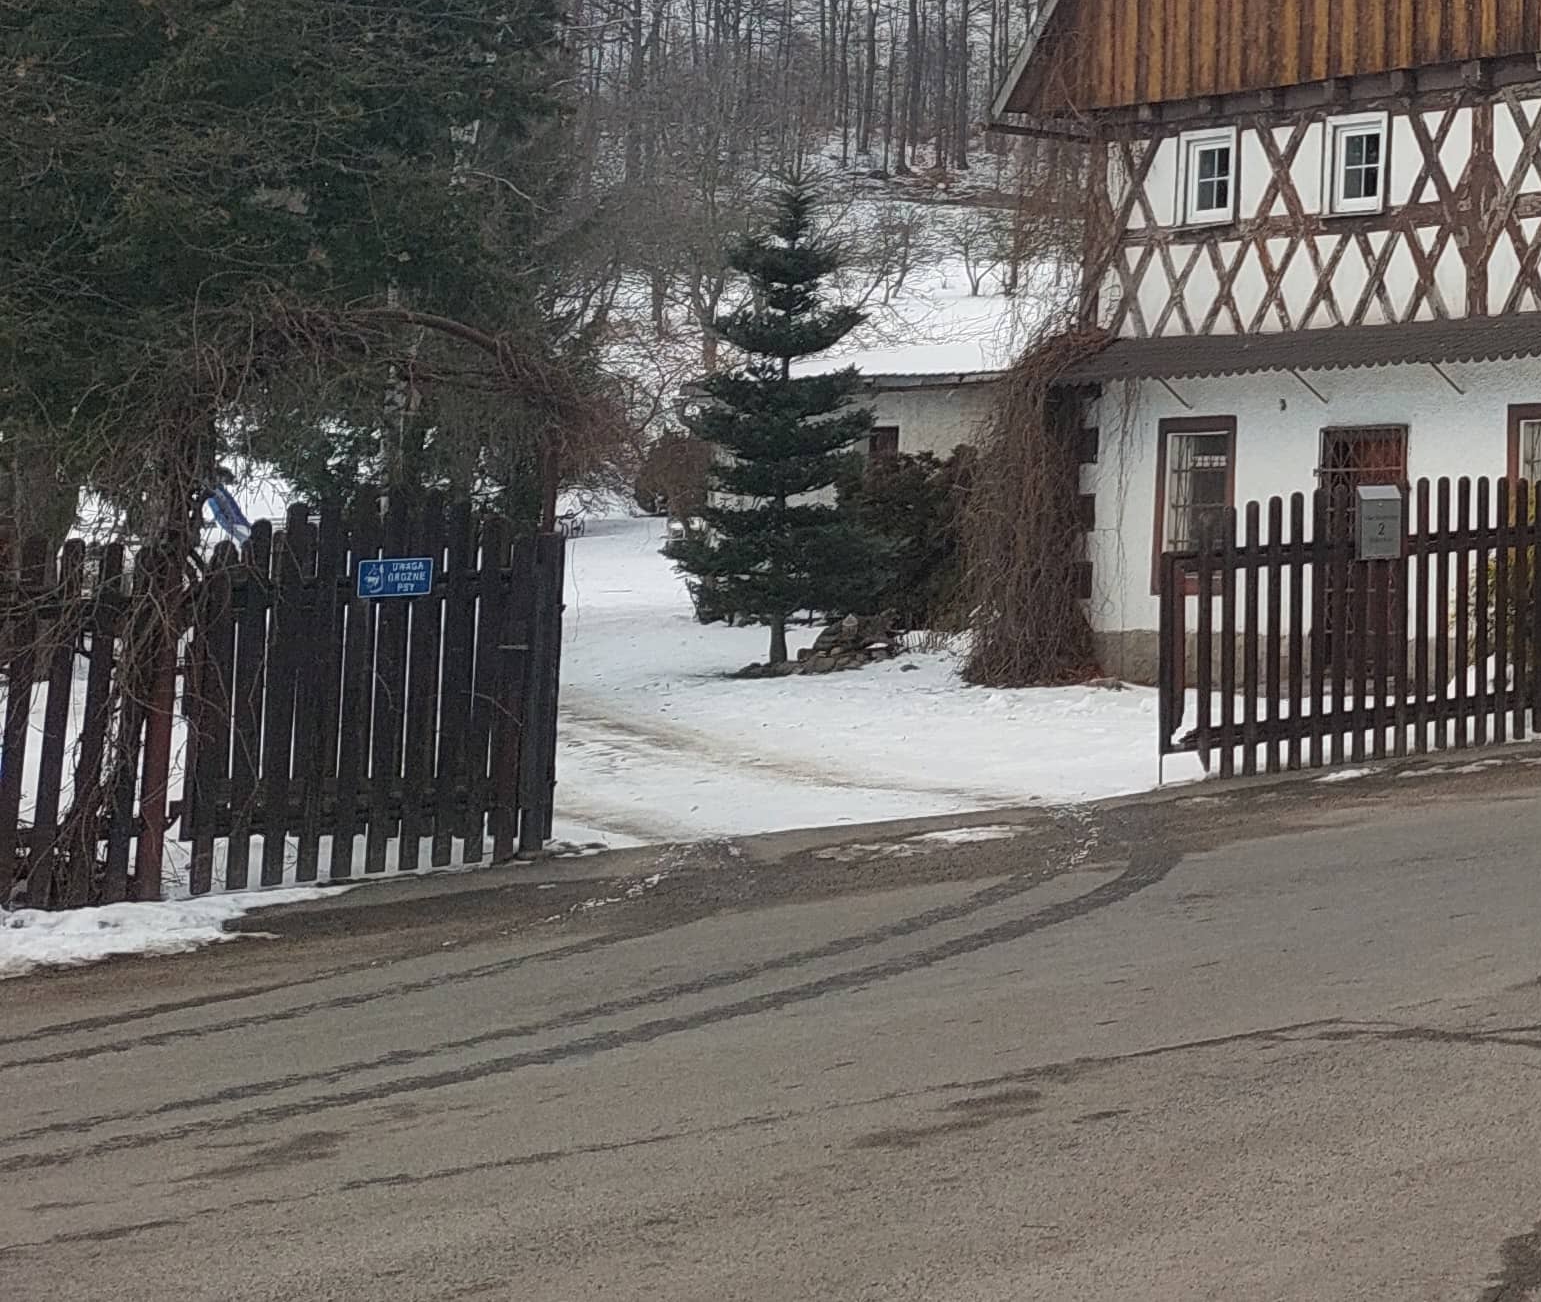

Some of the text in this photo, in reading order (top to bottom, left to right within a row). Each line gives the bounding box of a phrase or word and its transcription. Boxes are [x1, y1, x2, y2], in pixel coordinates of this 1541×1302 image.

[1377, 522, 1385, 536] 2
[392, 561, 424, 572] UWAGA
[397, 582, 415, 593] PSY
